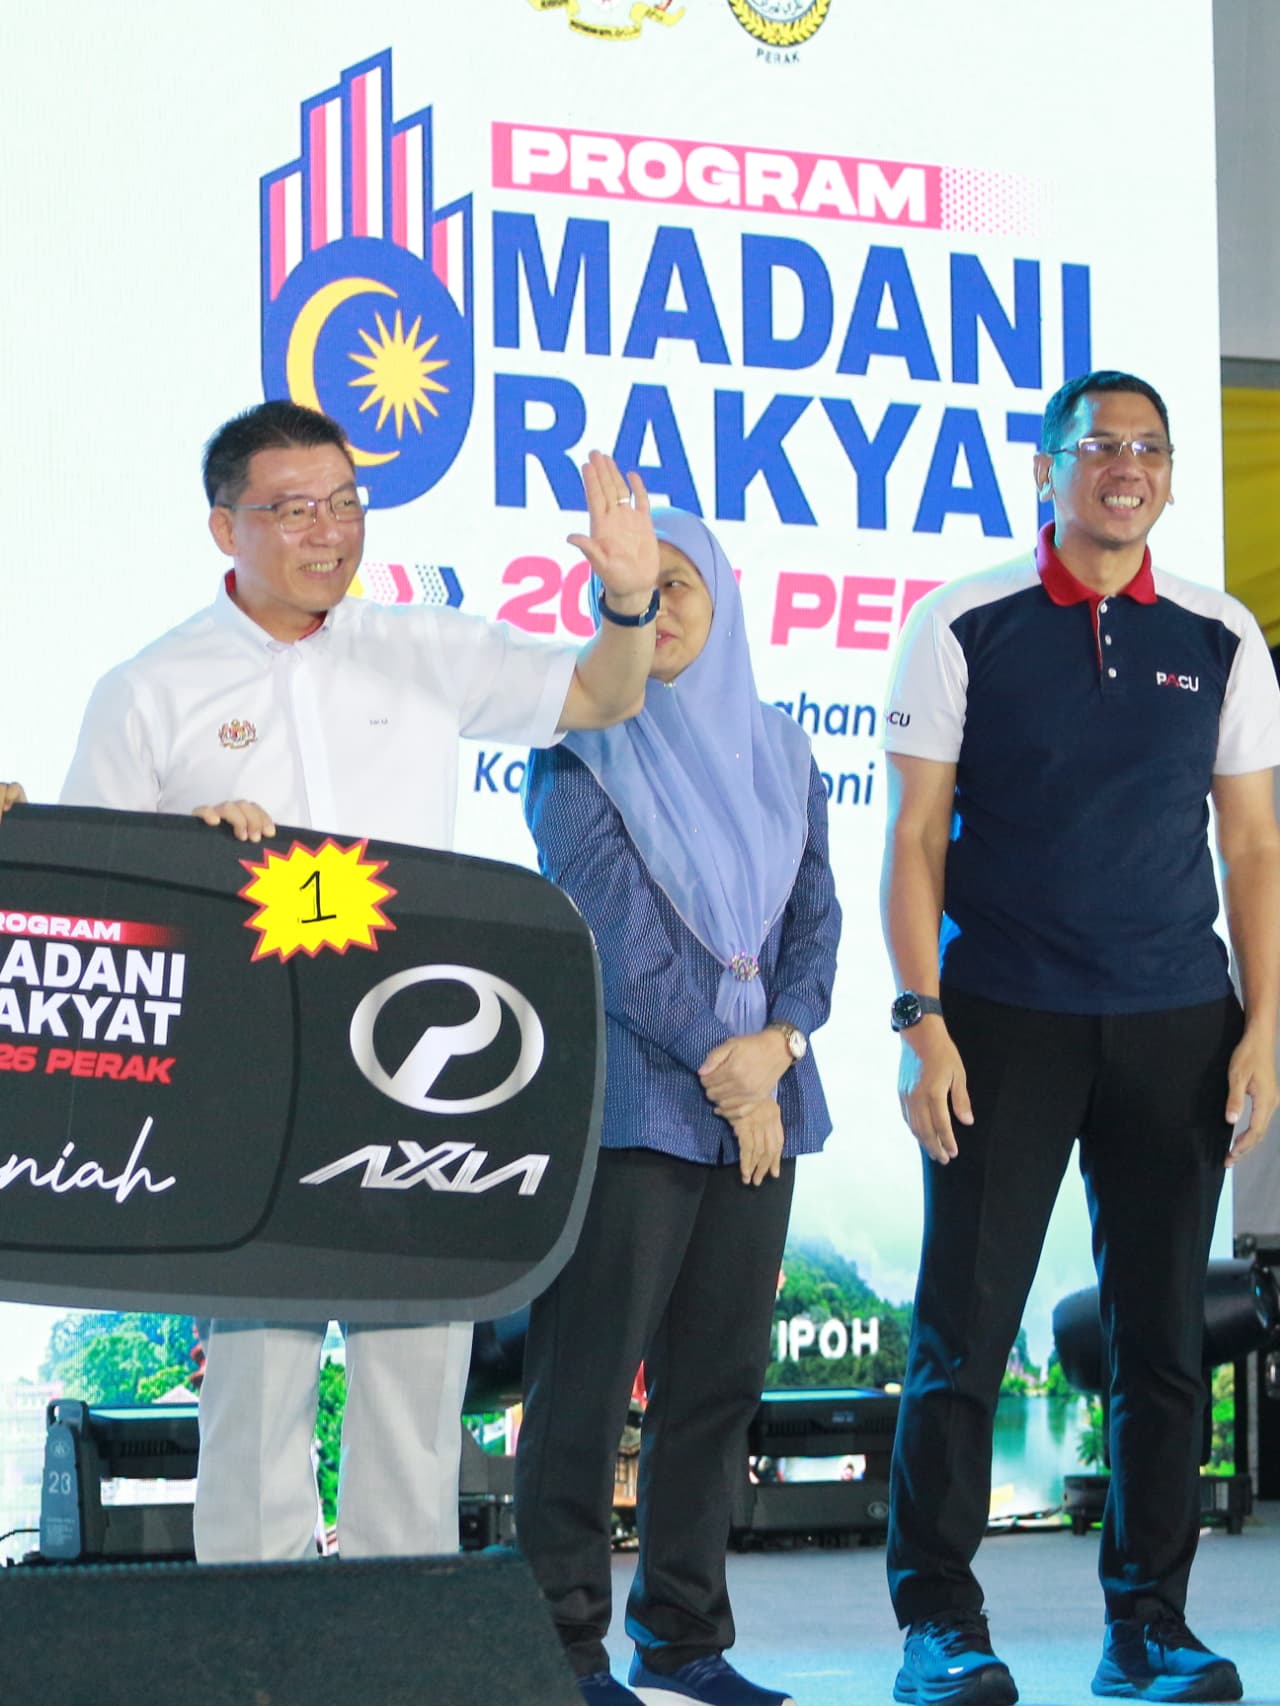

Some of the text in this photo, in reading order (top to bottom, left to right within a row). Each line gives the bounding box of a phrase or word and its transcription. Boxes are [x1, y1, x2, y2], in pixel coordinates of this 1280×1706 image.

[511, 128, 926, 222] PROGRAM
[492, 210, 1091, 389] MADANI
[1156, 672, 1199, 692] PACU
[297, 871, 337, 924] 1
[45, 1048, 177, 1084] PERAK
[777, 1315, 879, 1362] IPOH
